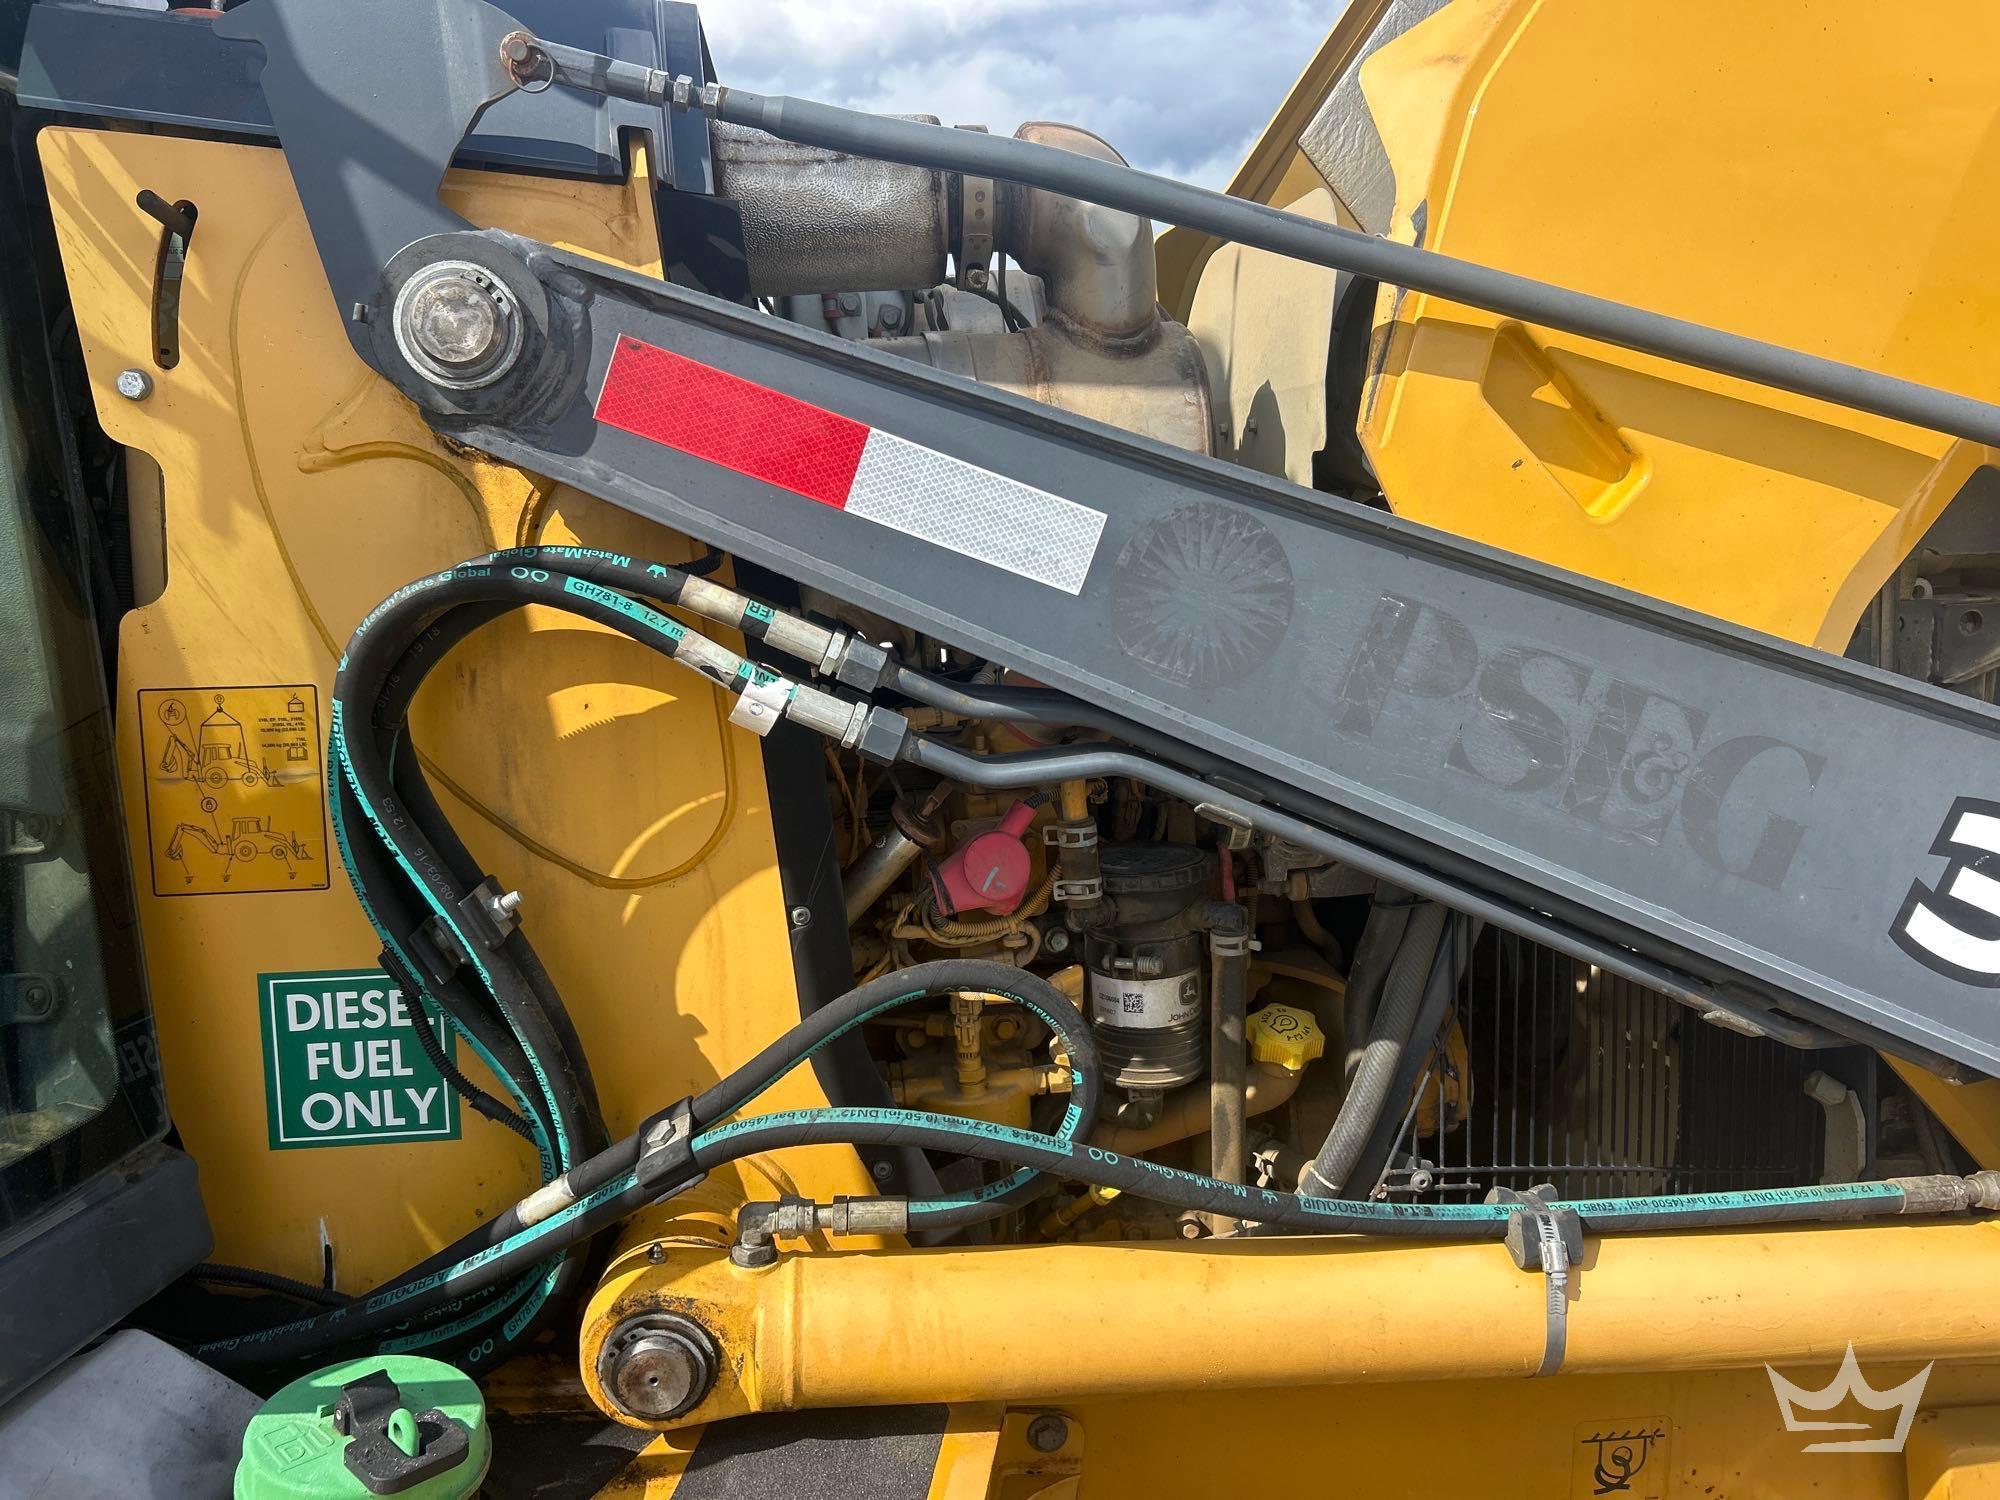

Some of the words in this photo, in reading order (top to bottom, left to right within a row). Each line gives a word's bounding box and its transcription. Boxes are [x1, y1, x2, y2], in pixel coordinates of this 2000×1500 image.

[542, 546, 631, 568] MatchMate
[438, 567, 491, 584] Global
[573, 581, 633, 612] GH781-8
[643, 610, 668, 630] 12.7
[287, 990, 434, 1031] DIESE
[307, 1039, 413, 1080] FUEL
[301, 1087, 438, 1131] ONLY
[1303, 1198, 1378, 1216] AEROQUIP
[1652, 1197, 1685, 1210] (4500
[1685, 1196, 1707, 1207] bar
[1708, 1195, 1730, 1206] 310
[1743, 1192, 1775, 1203] DN12
[369, 1271, 450, 1310] AEROQUIP
